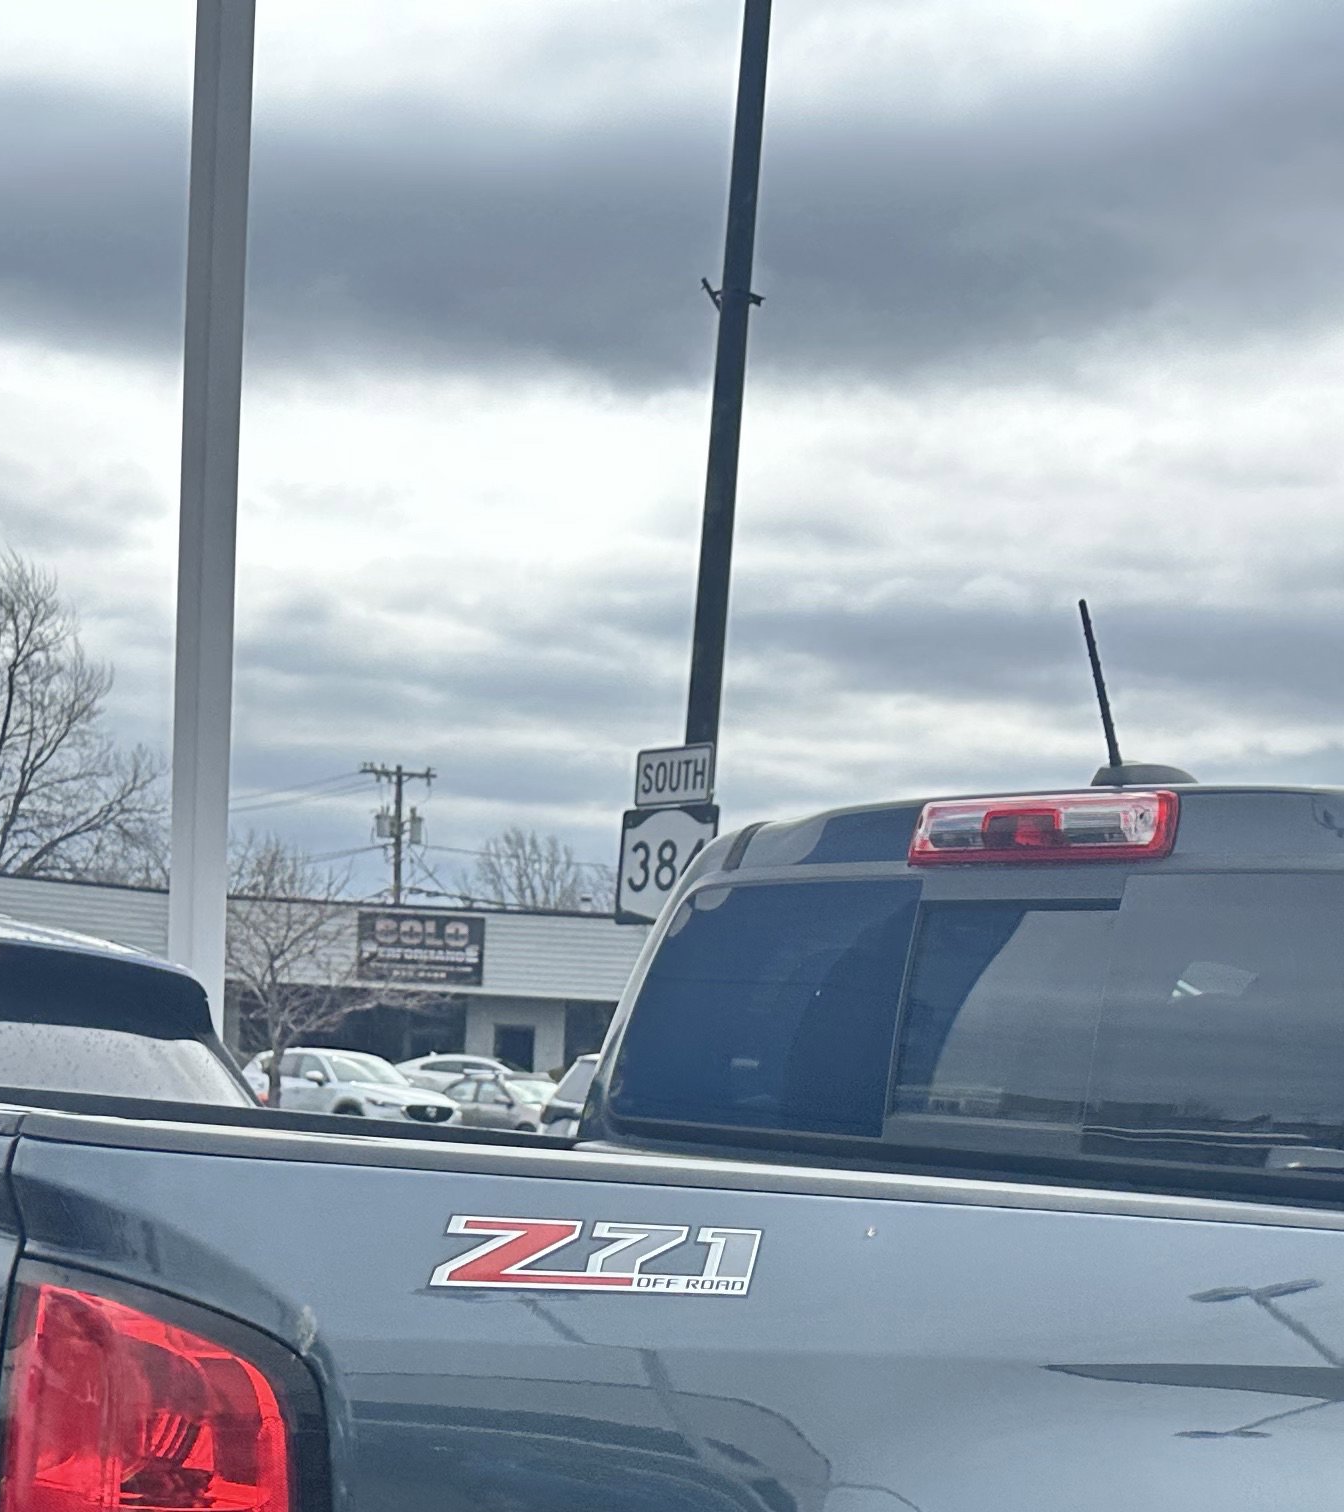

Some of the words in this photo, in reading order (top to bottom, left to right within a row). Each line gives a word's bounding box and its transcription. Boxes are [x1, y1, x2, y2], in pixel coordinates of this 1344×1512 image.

[641, 758, 707, 795] SOUTH
[429, 1214, 762, 1296] Z71
[636, 1277, 681, 1290] OFF
[685, 1278, 746, 1292] ROAD
